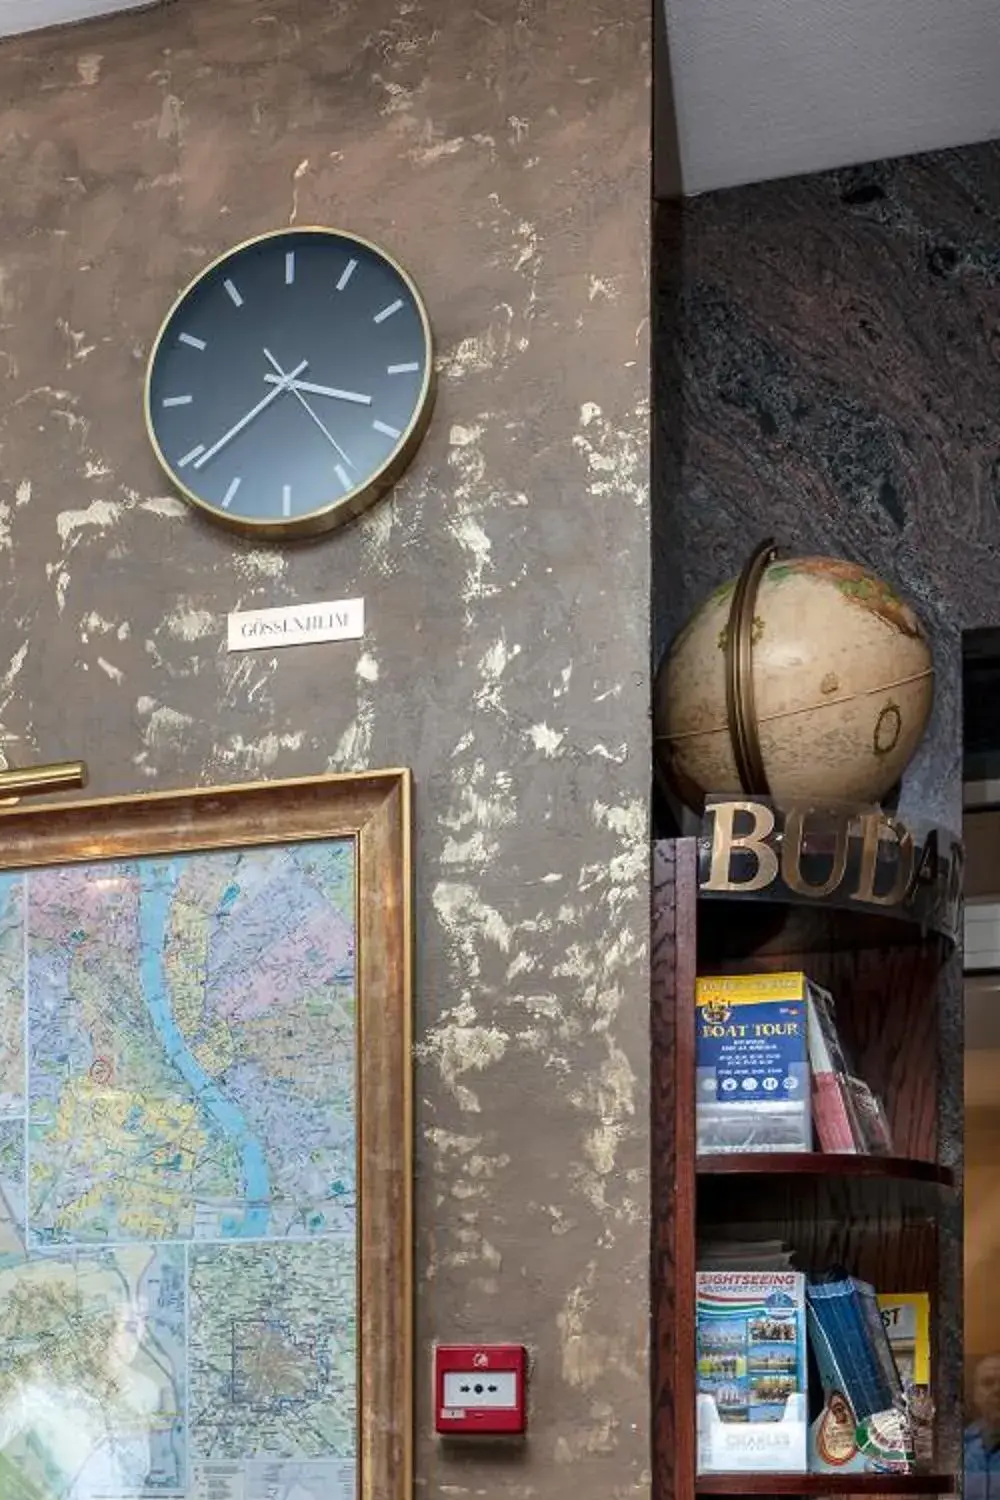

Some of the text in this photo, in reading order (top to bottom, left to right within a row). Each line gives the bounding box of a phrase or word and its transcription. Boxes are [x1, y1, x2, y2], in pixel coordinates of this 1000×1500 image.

[703, 1023, 799, 1038] BOAT TOUR
[699, 1274, 796, 1285] SIGHTSEEING
